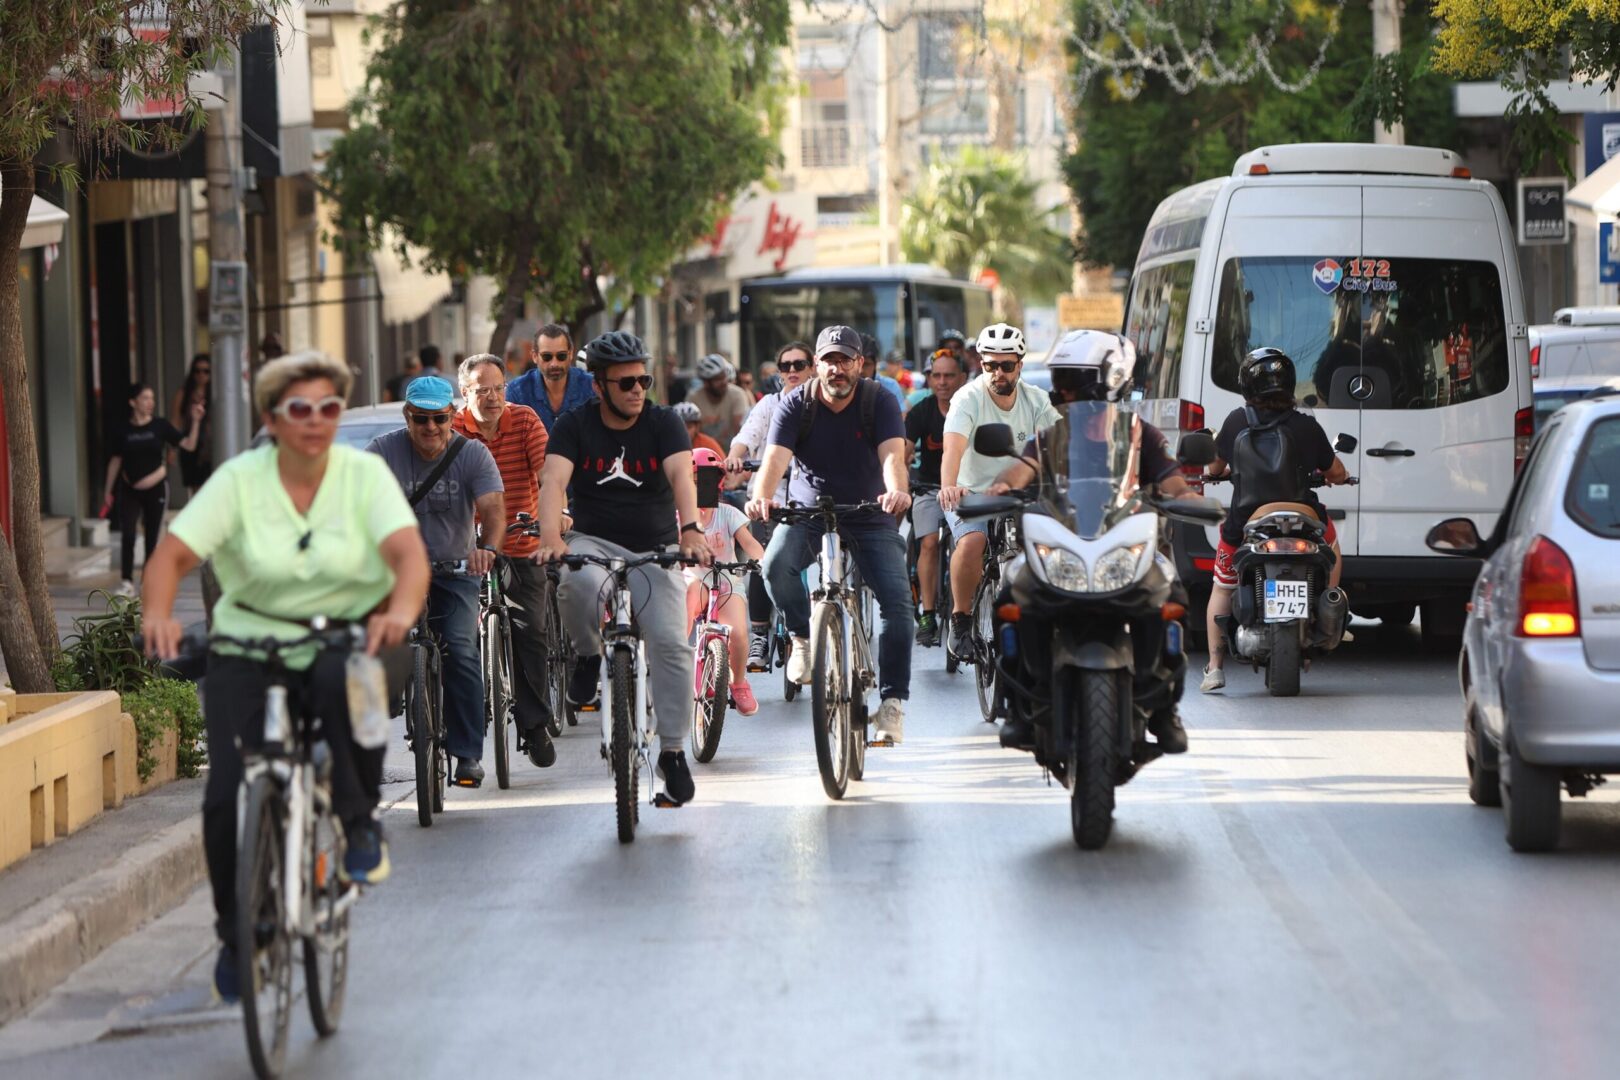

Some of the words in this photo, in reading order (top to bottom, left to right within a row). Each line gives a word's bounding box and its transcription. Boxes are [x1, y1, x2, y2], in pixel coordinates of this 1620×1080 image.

[1350, 259, 1390, 277] 172
[1343, 277, 1371, 293] City
[1373, 278, 1397, 291] Bus
[1277, 585, 1306, 598] HHE
[1277, 602, 1306, 615] 747
